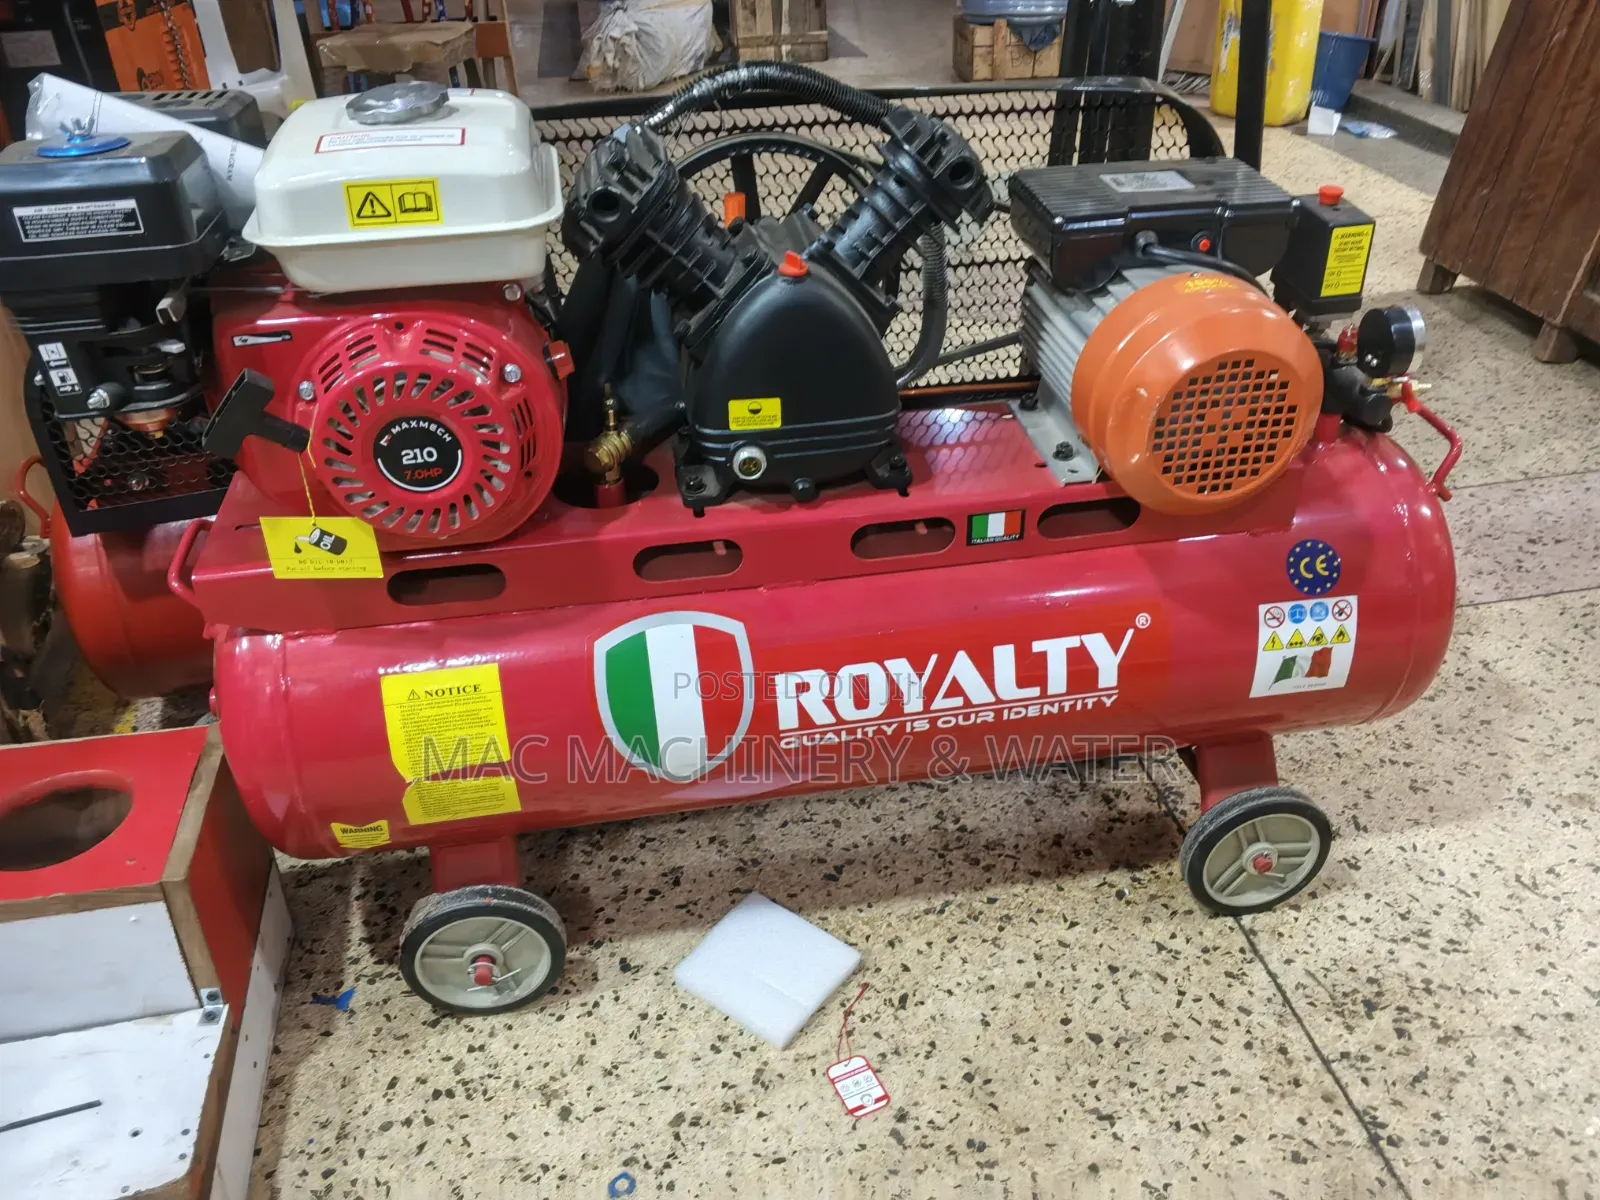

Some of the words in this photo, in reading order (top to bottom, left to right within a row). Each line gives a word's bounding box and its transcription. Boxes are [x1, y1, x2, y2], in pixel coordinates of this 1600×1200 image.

[390, 419, 452, 443] MAXMECH
[401, 446, 438, 465] 210
[403, 467, 443, 481] 7.0HP
[320, 534, 336, 551] OIL
[971, 537, 994, 545] ITALIAN
[994, 534, 1020, 542] QUALITY
[1299, 554, 1330, 579] CE
[774, 628, 1135, 731] ROYALTY
[424, 683, 482, 699] NOTICE
[779, 722, 899, 750] QUALITY
[905, 718, 931, 734] IS
[936, 711, 995, 728] OUR
[1002, 694, 1119, 721] IDENTITY
[339, 824, 384, 835] WARNING
